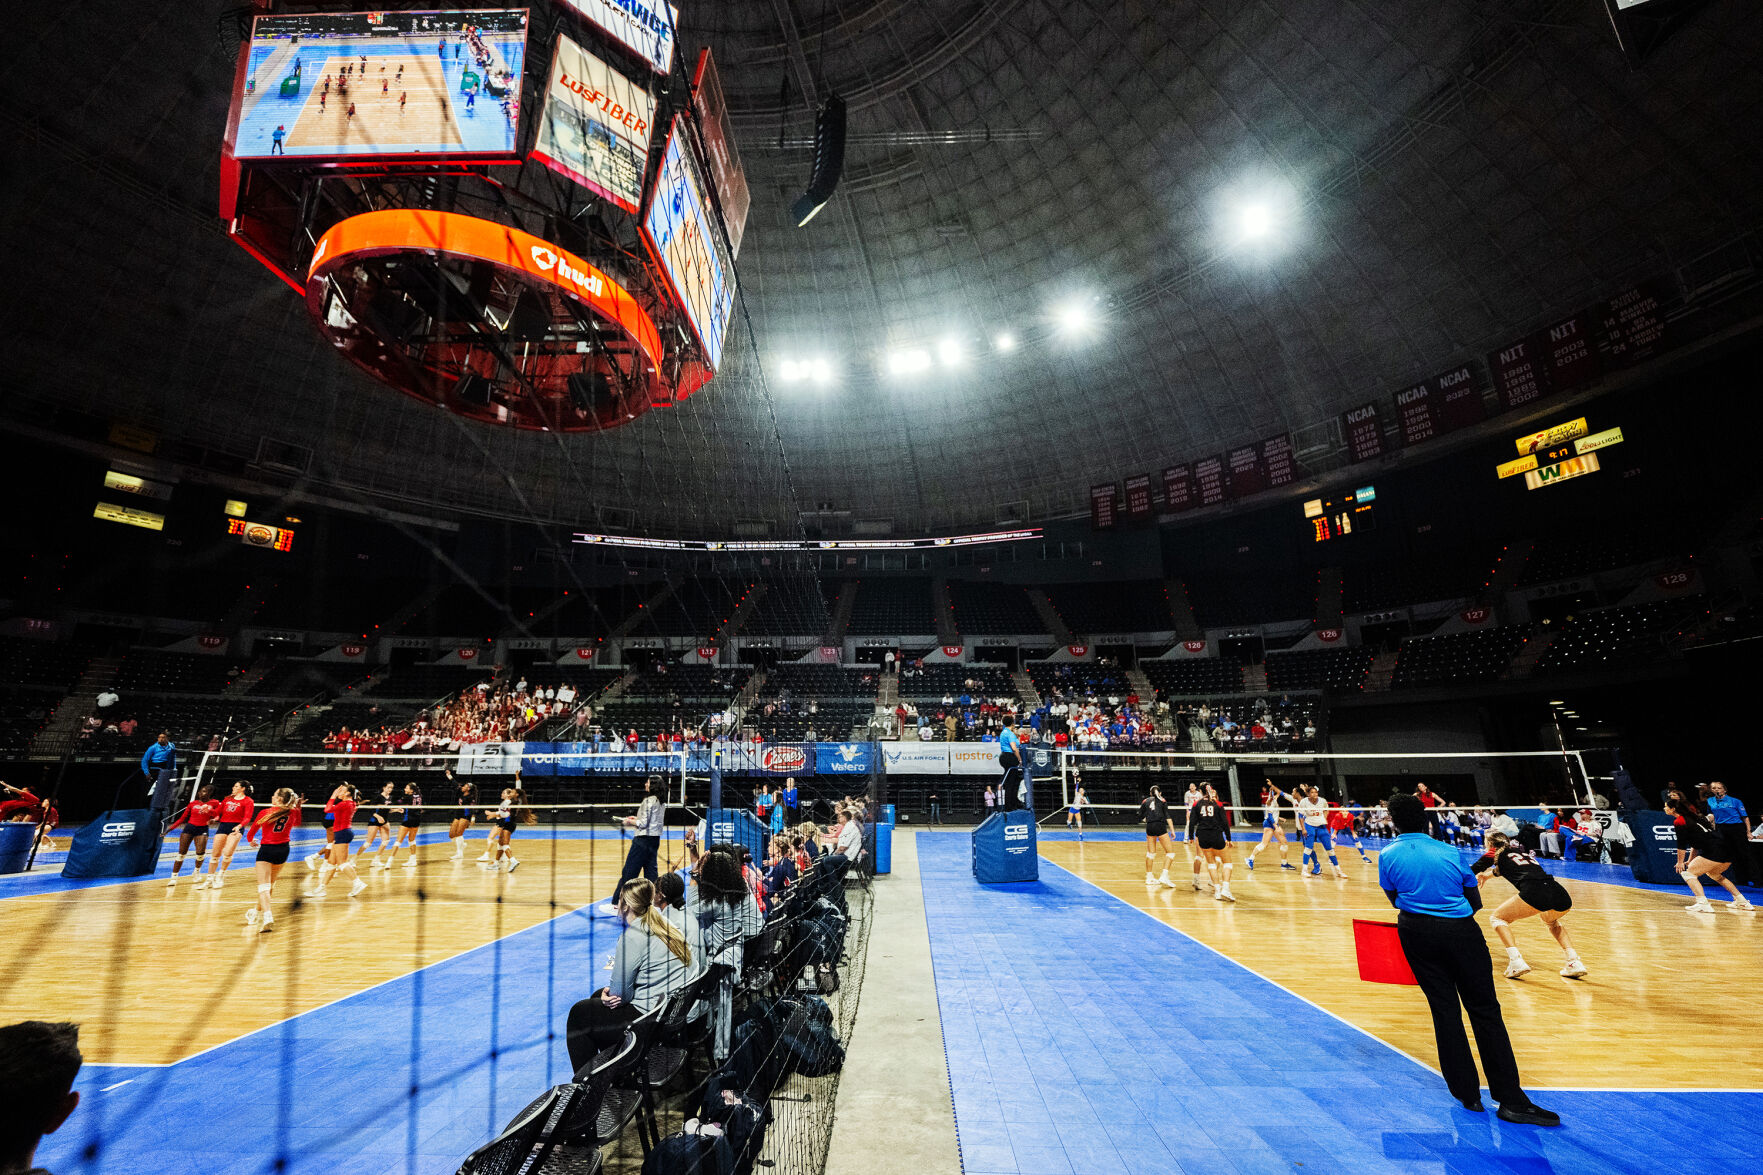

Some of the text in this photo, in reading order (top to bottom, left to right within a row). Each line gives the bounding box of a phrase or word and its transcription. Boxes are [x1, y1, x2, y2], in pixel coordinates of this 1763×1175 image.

[612, 0, 670, 42] RVICE
[559, 73, 648, 136] LUSFIBER
[558, 257, 604, 297] hudl
[1550, 319, 1577, 342] NIT
[1499, 343, 1525, 365] NIT
[1439, 368, 1471, 390] NCAA
[1397, 385, 1429, 406] NCAA
[1346, 404, 1376, 425] NCAA
[1601, 434, 1623, 444] LIGHT
[1537, 457, 1586, 482] WM
[1663, 573, 1688, 585] 128
[1466, 610, 1484, 619] 127
[1321, 630, 1337, 638] 126
[831, 762, 865, 772] Valero
[1149, 801, 1156, 811] 4
[1200, 805, 1214, 817] 49
[273, 815, 289, 833] 8
